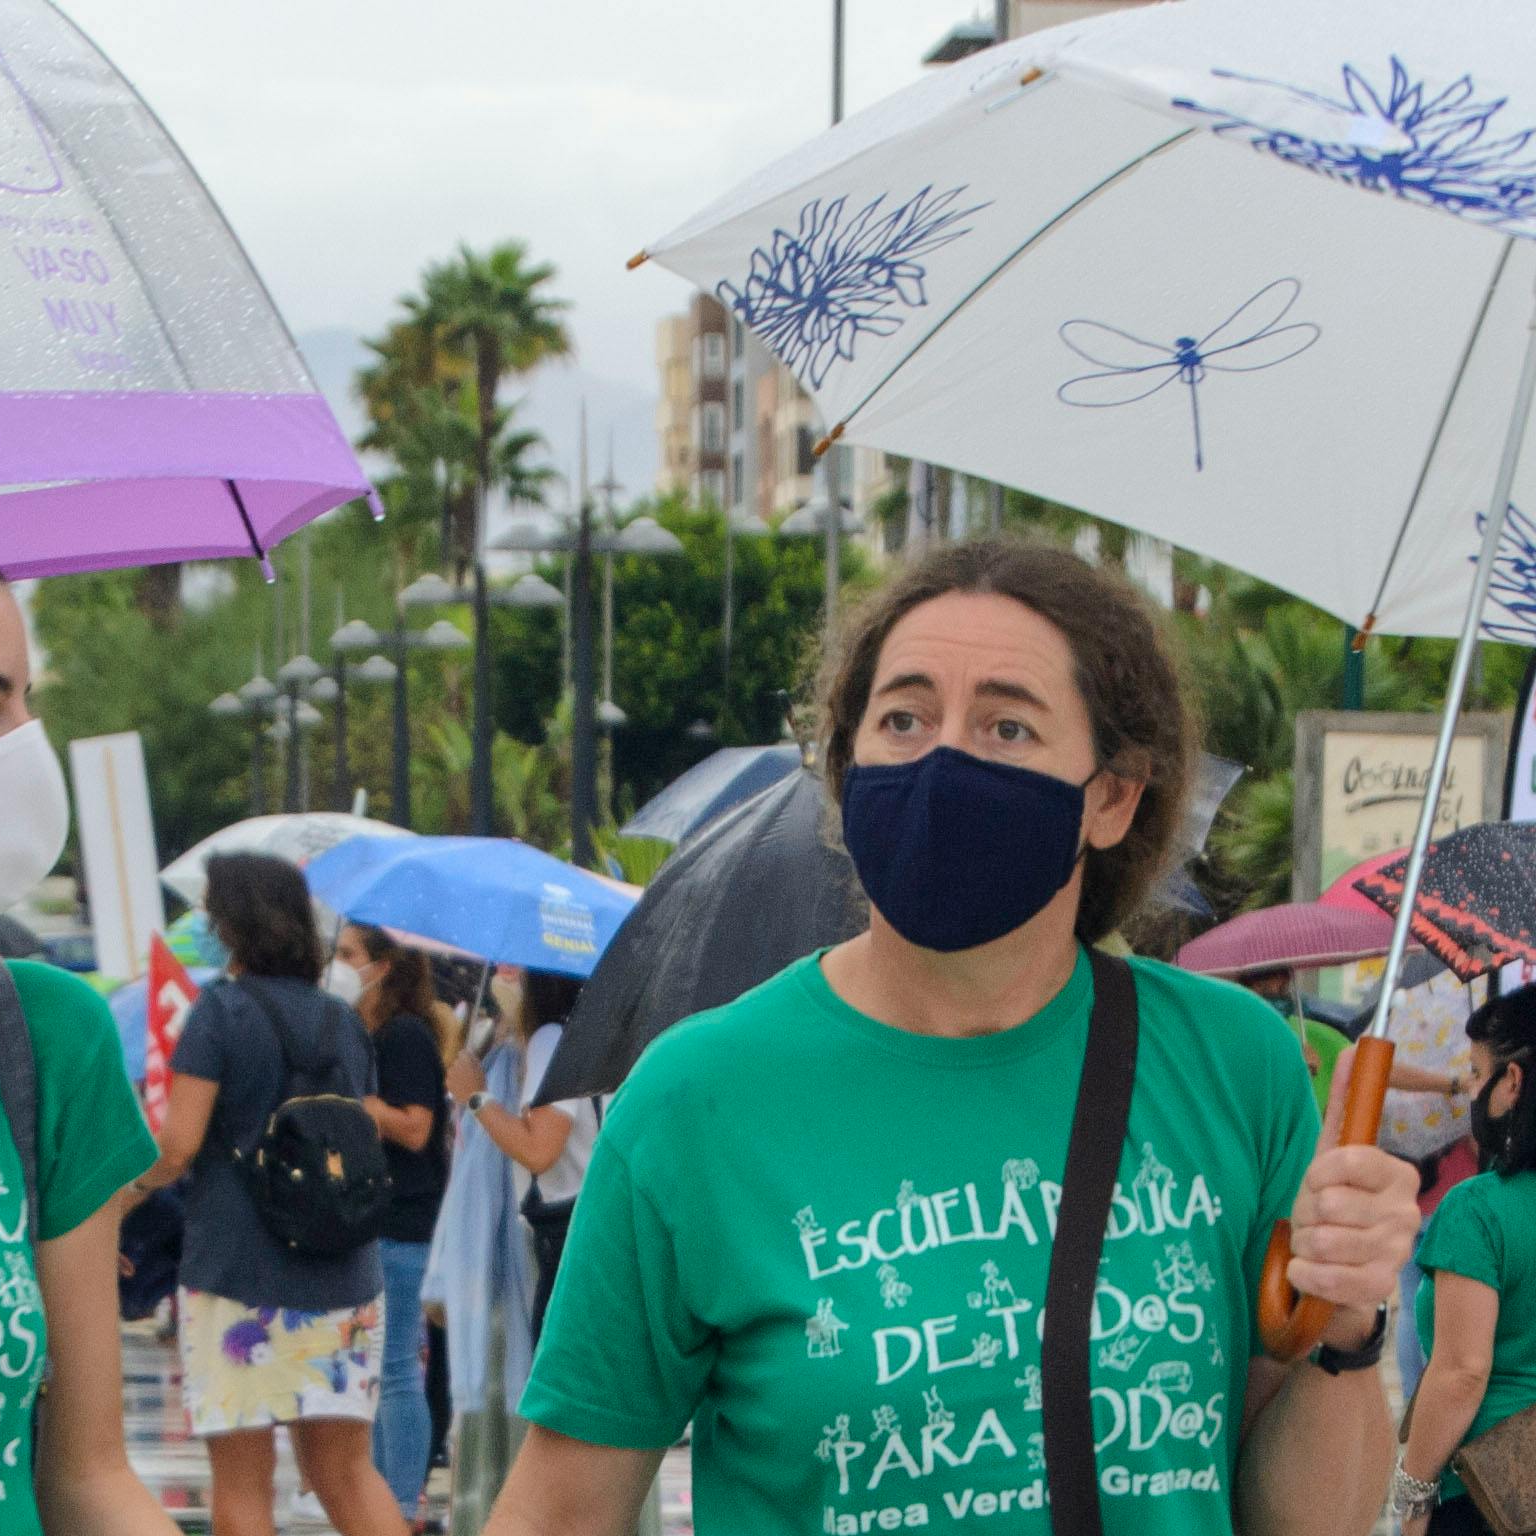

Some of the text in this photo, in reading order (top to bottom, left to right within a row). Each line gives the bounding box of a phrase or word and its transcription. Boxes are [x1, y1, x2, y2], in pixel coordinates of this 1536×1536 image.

[13, 244, 110, 285] VASO
[42, 297, 124, 338] MUY
[800, 1181, 1039, 1281] ESCUELA
[872, 1314, 978, 1386] DE
[835, 1386, 1225, 1496] PARA OD@S
[943, 1477, 1052, 1521] Verd
